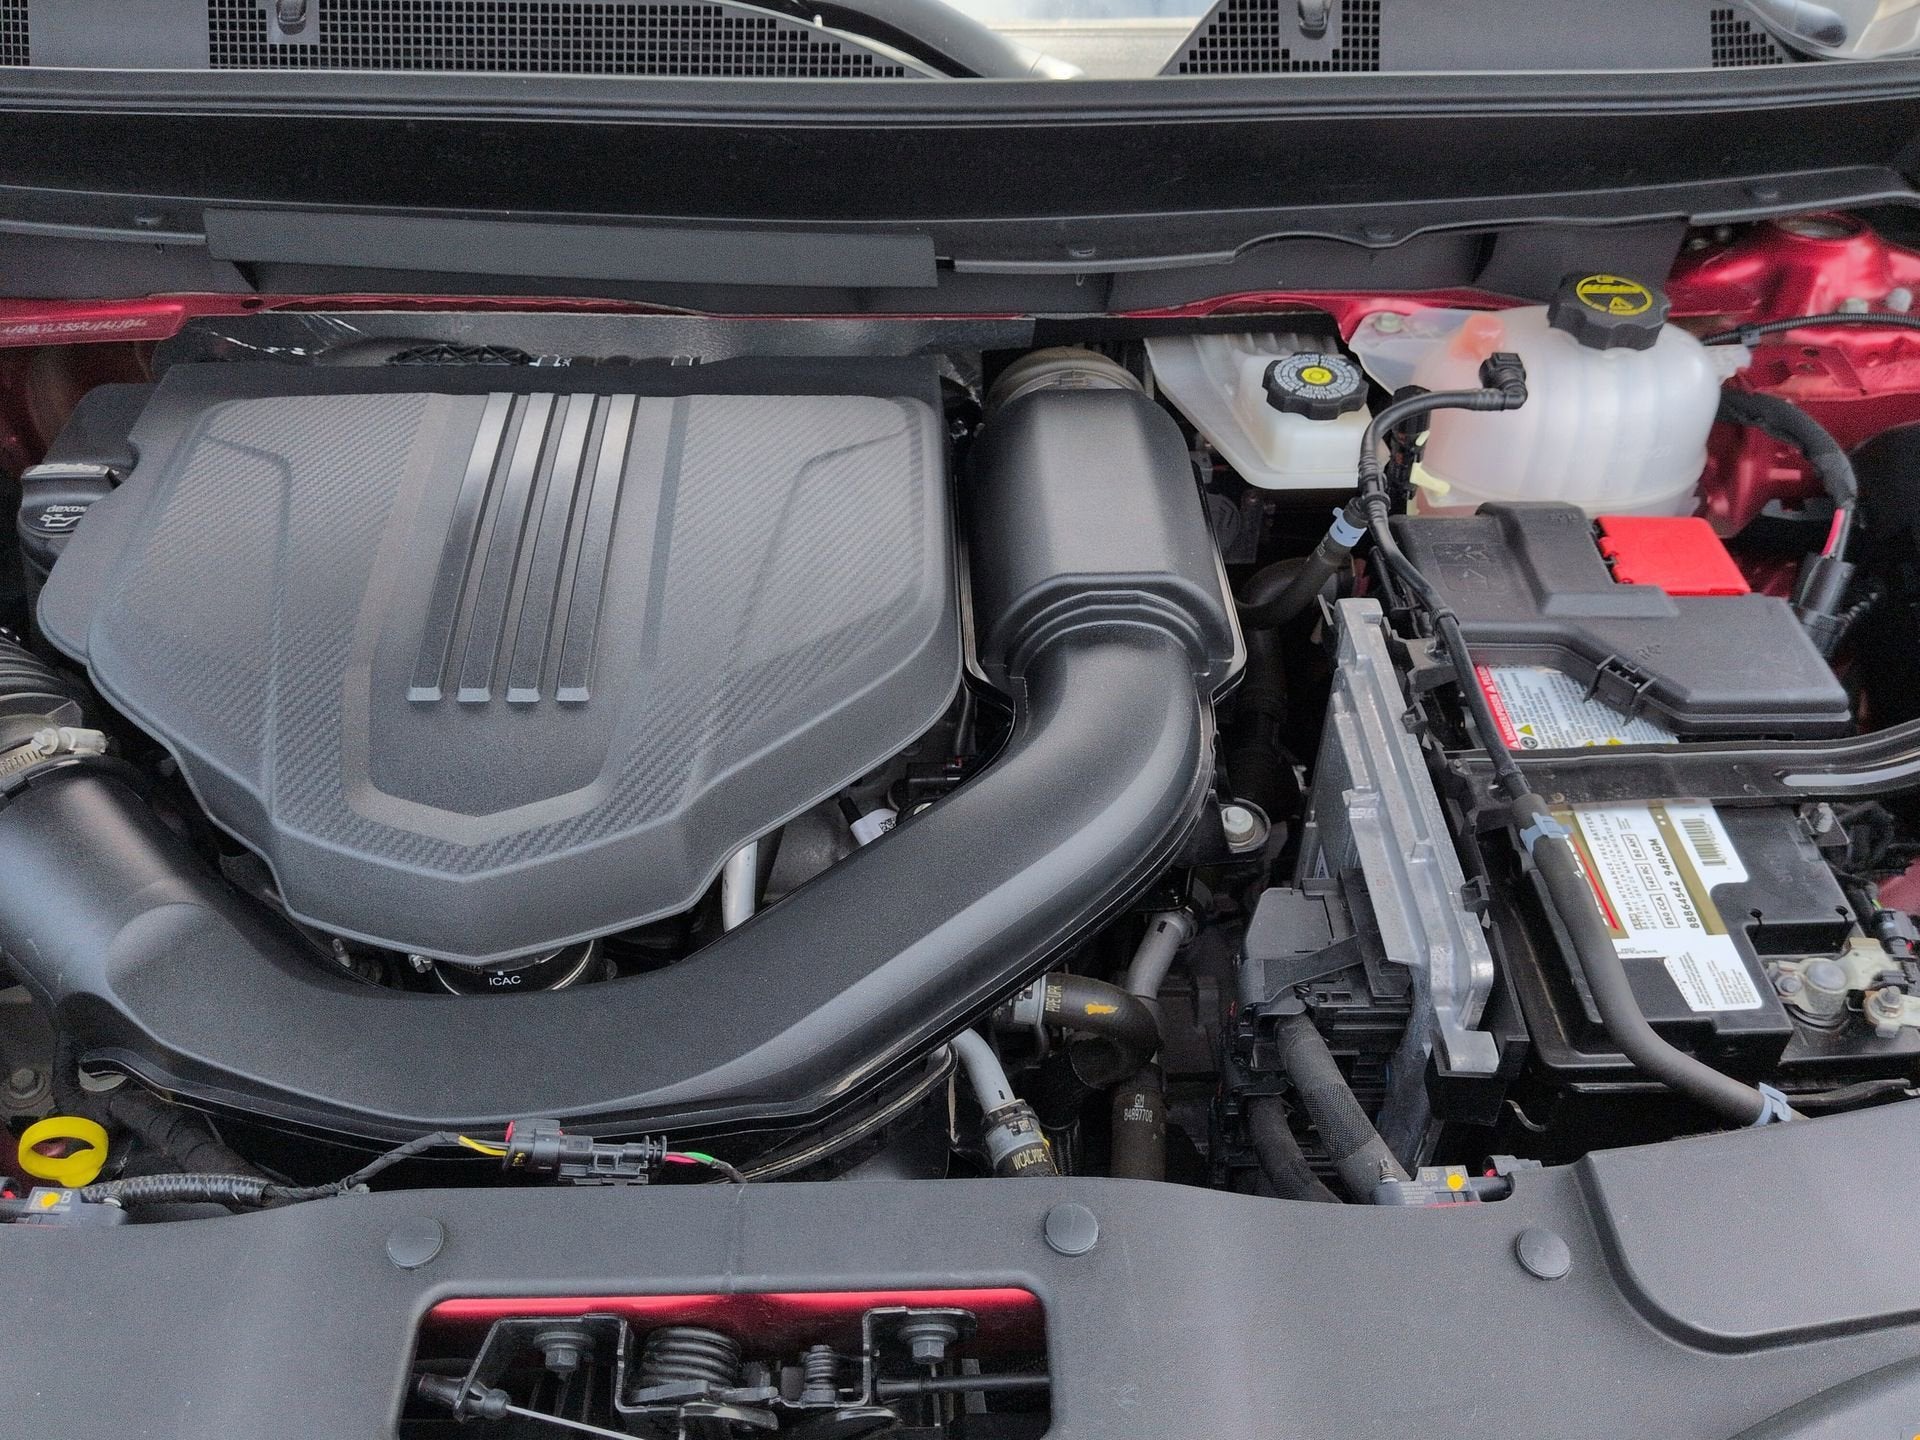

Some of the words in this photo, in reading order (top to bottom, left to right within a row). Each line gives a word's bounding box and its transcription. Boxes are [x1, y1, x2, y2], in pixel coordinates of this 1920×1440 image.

[1632, 849, 1643, 858] 80
[1647, 838, 1675, 877] 94RAGM
[1640, 866, 1651, 875] RC
[1606, 862, 1633, 911] MAINTENANCE
[1645, 876, 1657, 888] 140
[1655, 896, 1668, 911] CCA
[1668, 880, 1700, 929] 88864542
[1662, 912, 1675, 926] 850
[488, 975, 522, 986] ICAC
[1134, 1093, 1145, 1107] GM
